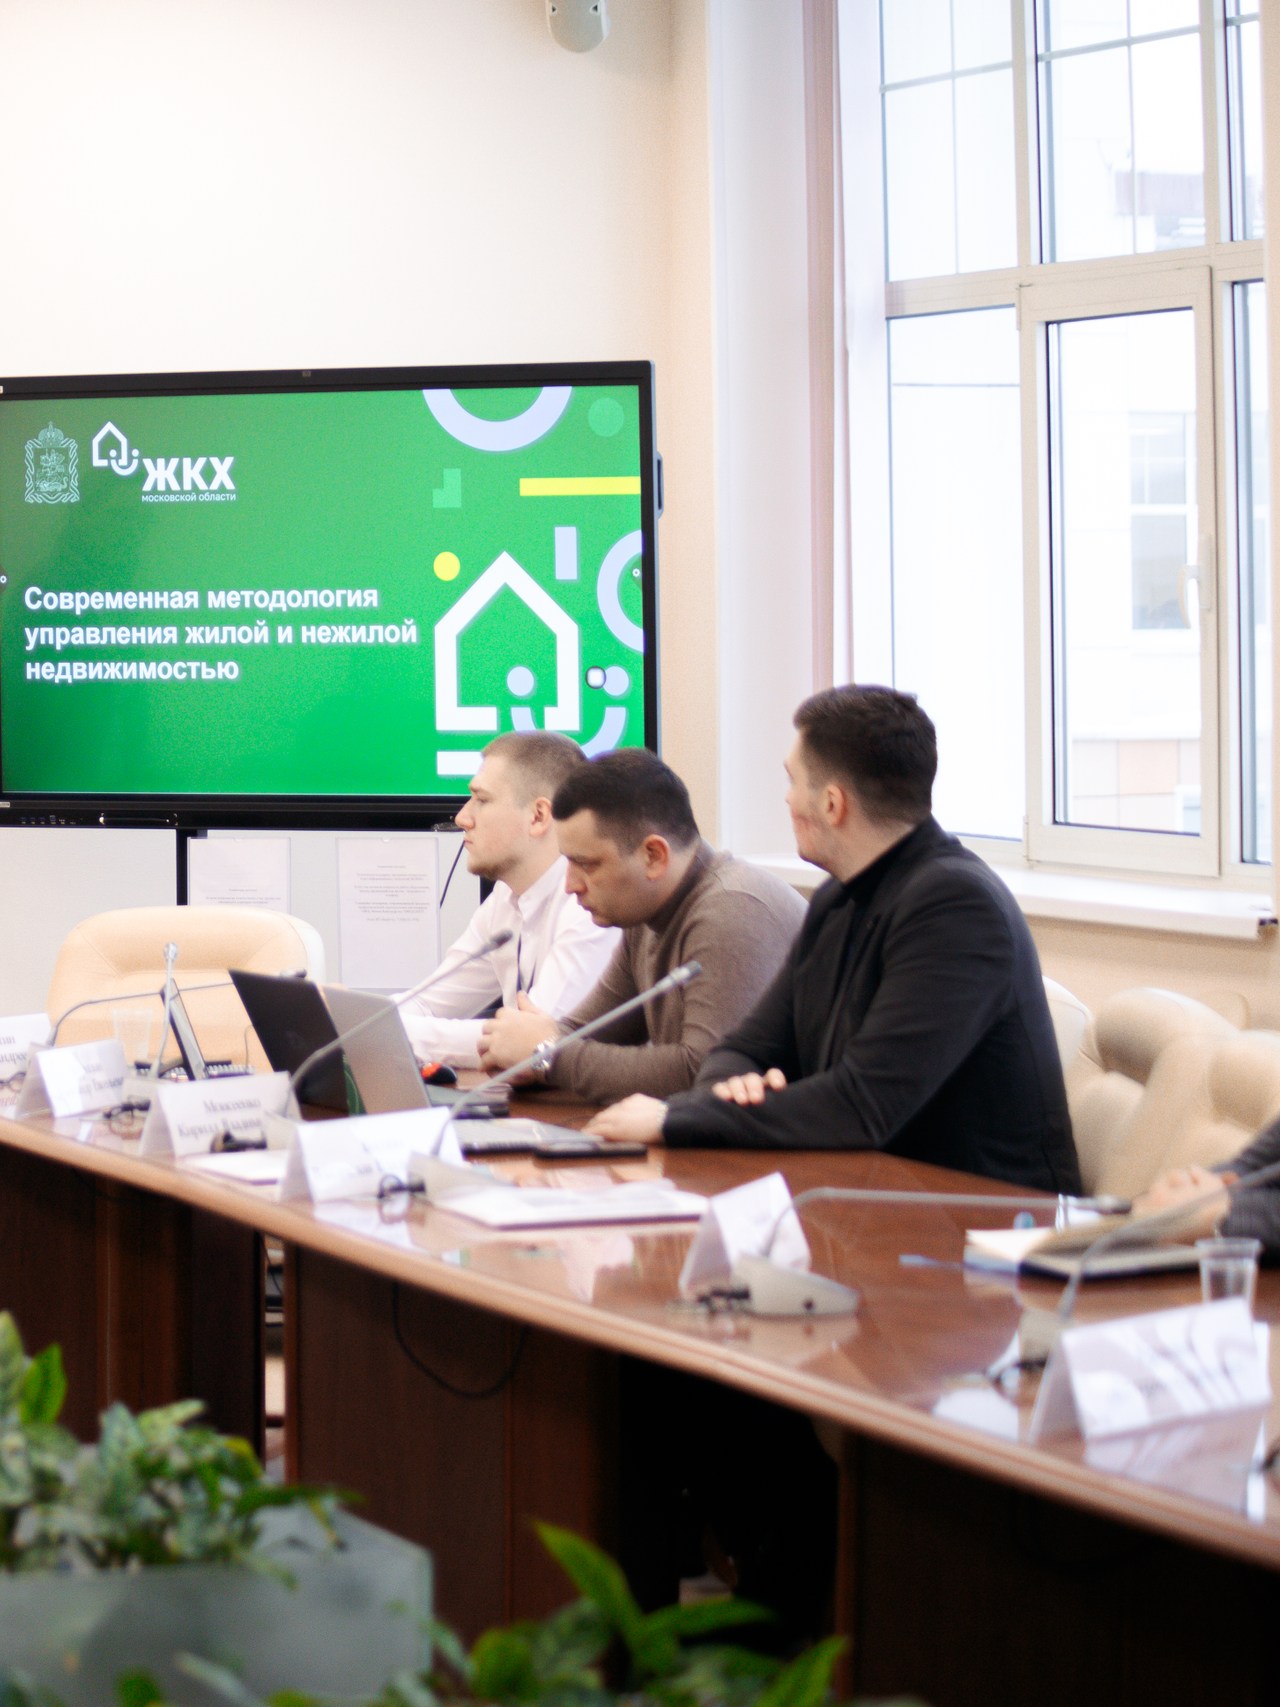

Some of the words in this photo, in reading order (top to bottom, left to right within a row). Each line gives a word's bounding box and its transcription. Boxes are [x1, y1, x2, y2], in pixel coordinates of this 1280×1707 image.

[142, 457, 235, 491] ЖКХ
[142, 492, 196, 502] московской
[199, 492, 236, 502] области
[24, 586, 199, 615] Современная
[208, 589, 378, 612] методология
[24, 626, 177, 651] управления
[185, 620, 269, 643] жилой
[277, 626, 293, 643] и
[301, 618, 417, 643] нежилой
[25, 661, 239, 684] недвижимостью
